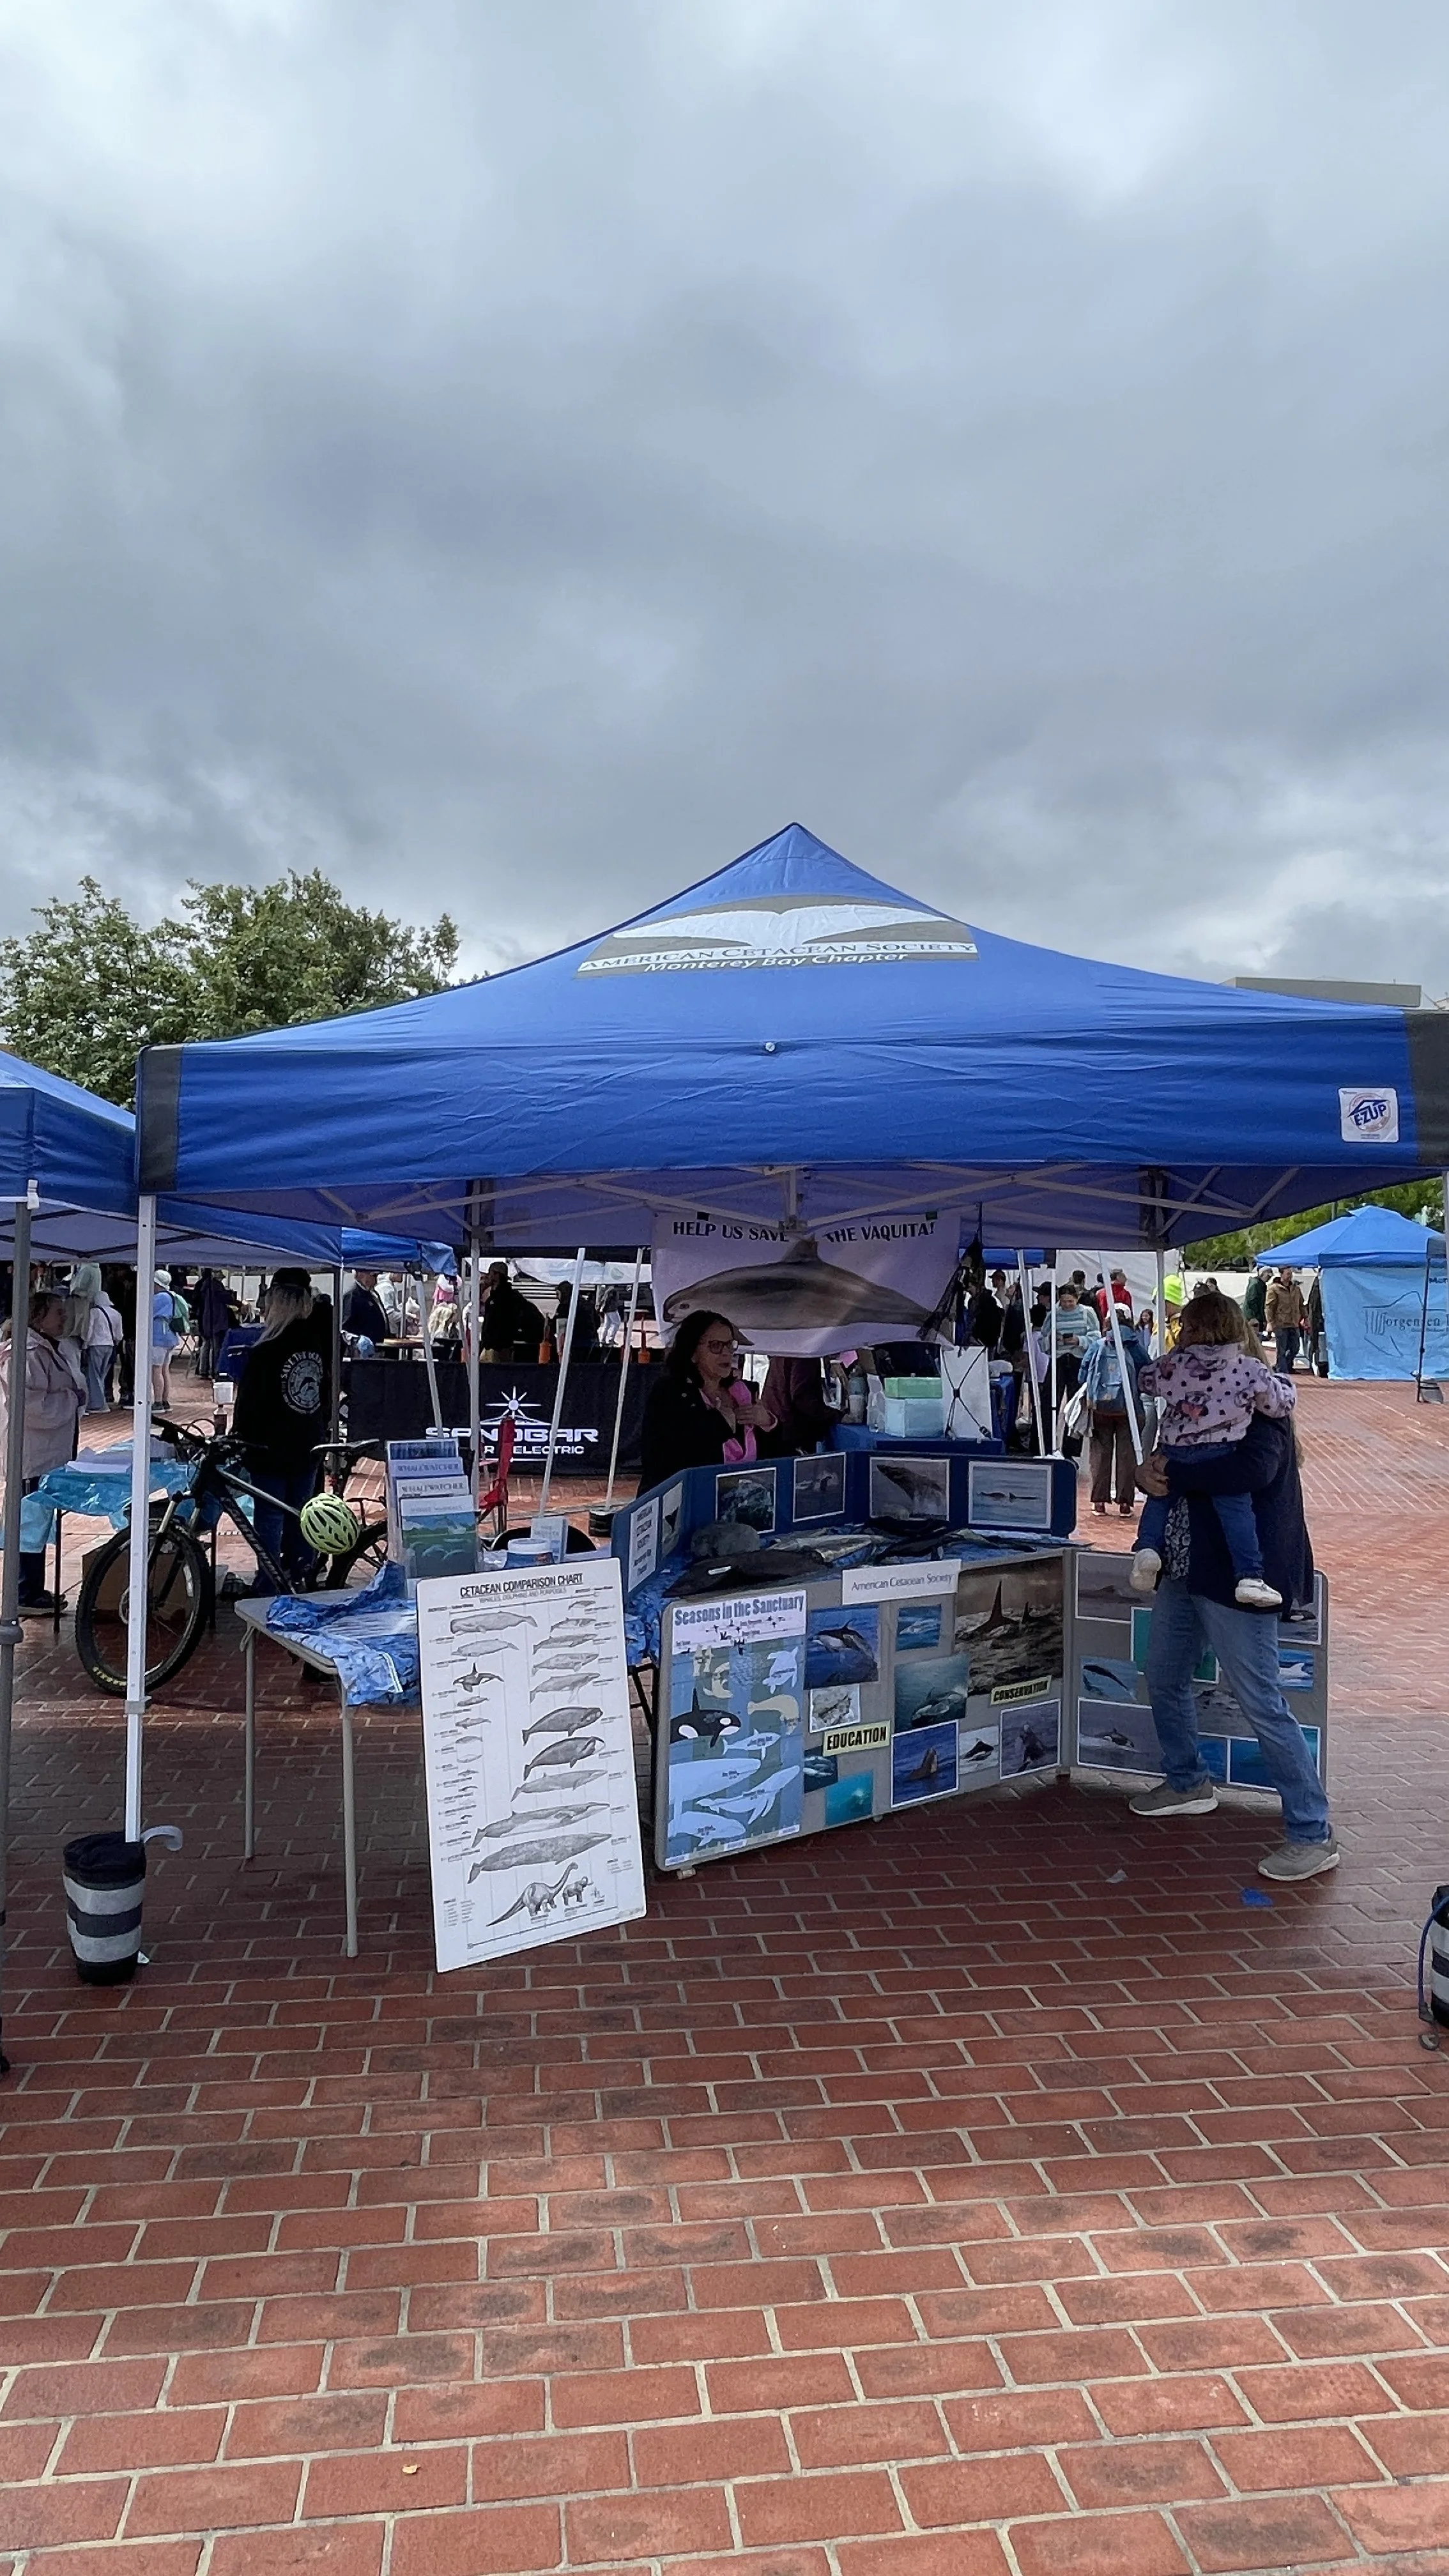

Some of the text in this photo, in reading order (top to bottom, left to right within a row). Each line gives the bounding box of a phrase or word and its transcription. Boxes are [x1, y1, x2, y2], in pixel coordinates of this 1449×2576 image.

[582, 943, 973, 969] AMERICAN CETACEAN SOCIETY
[643, 953, 909, 973] Monterey Bay Chapter
[673, 1221, 935, 1243] HELP US SAVE THE VAQUITA!
[1379, 1310, 1441, 1336] Jorgenen
[513, 1445, 585, 1455] ELECTRIC
[460, 1573, 583, 1597] CETACEAN COMPARISON CHART
[851, 1573, 953, 1591] American Cetacean Society
[675, 1606, 721, 1626] Seasons
[722, 1602, 732, 1620] in
[735, 1601, 751, 1618] the
[753, 1595, 804, 1615] Sanctuary
[827, 1726, 887, 1751] EDUCATION
